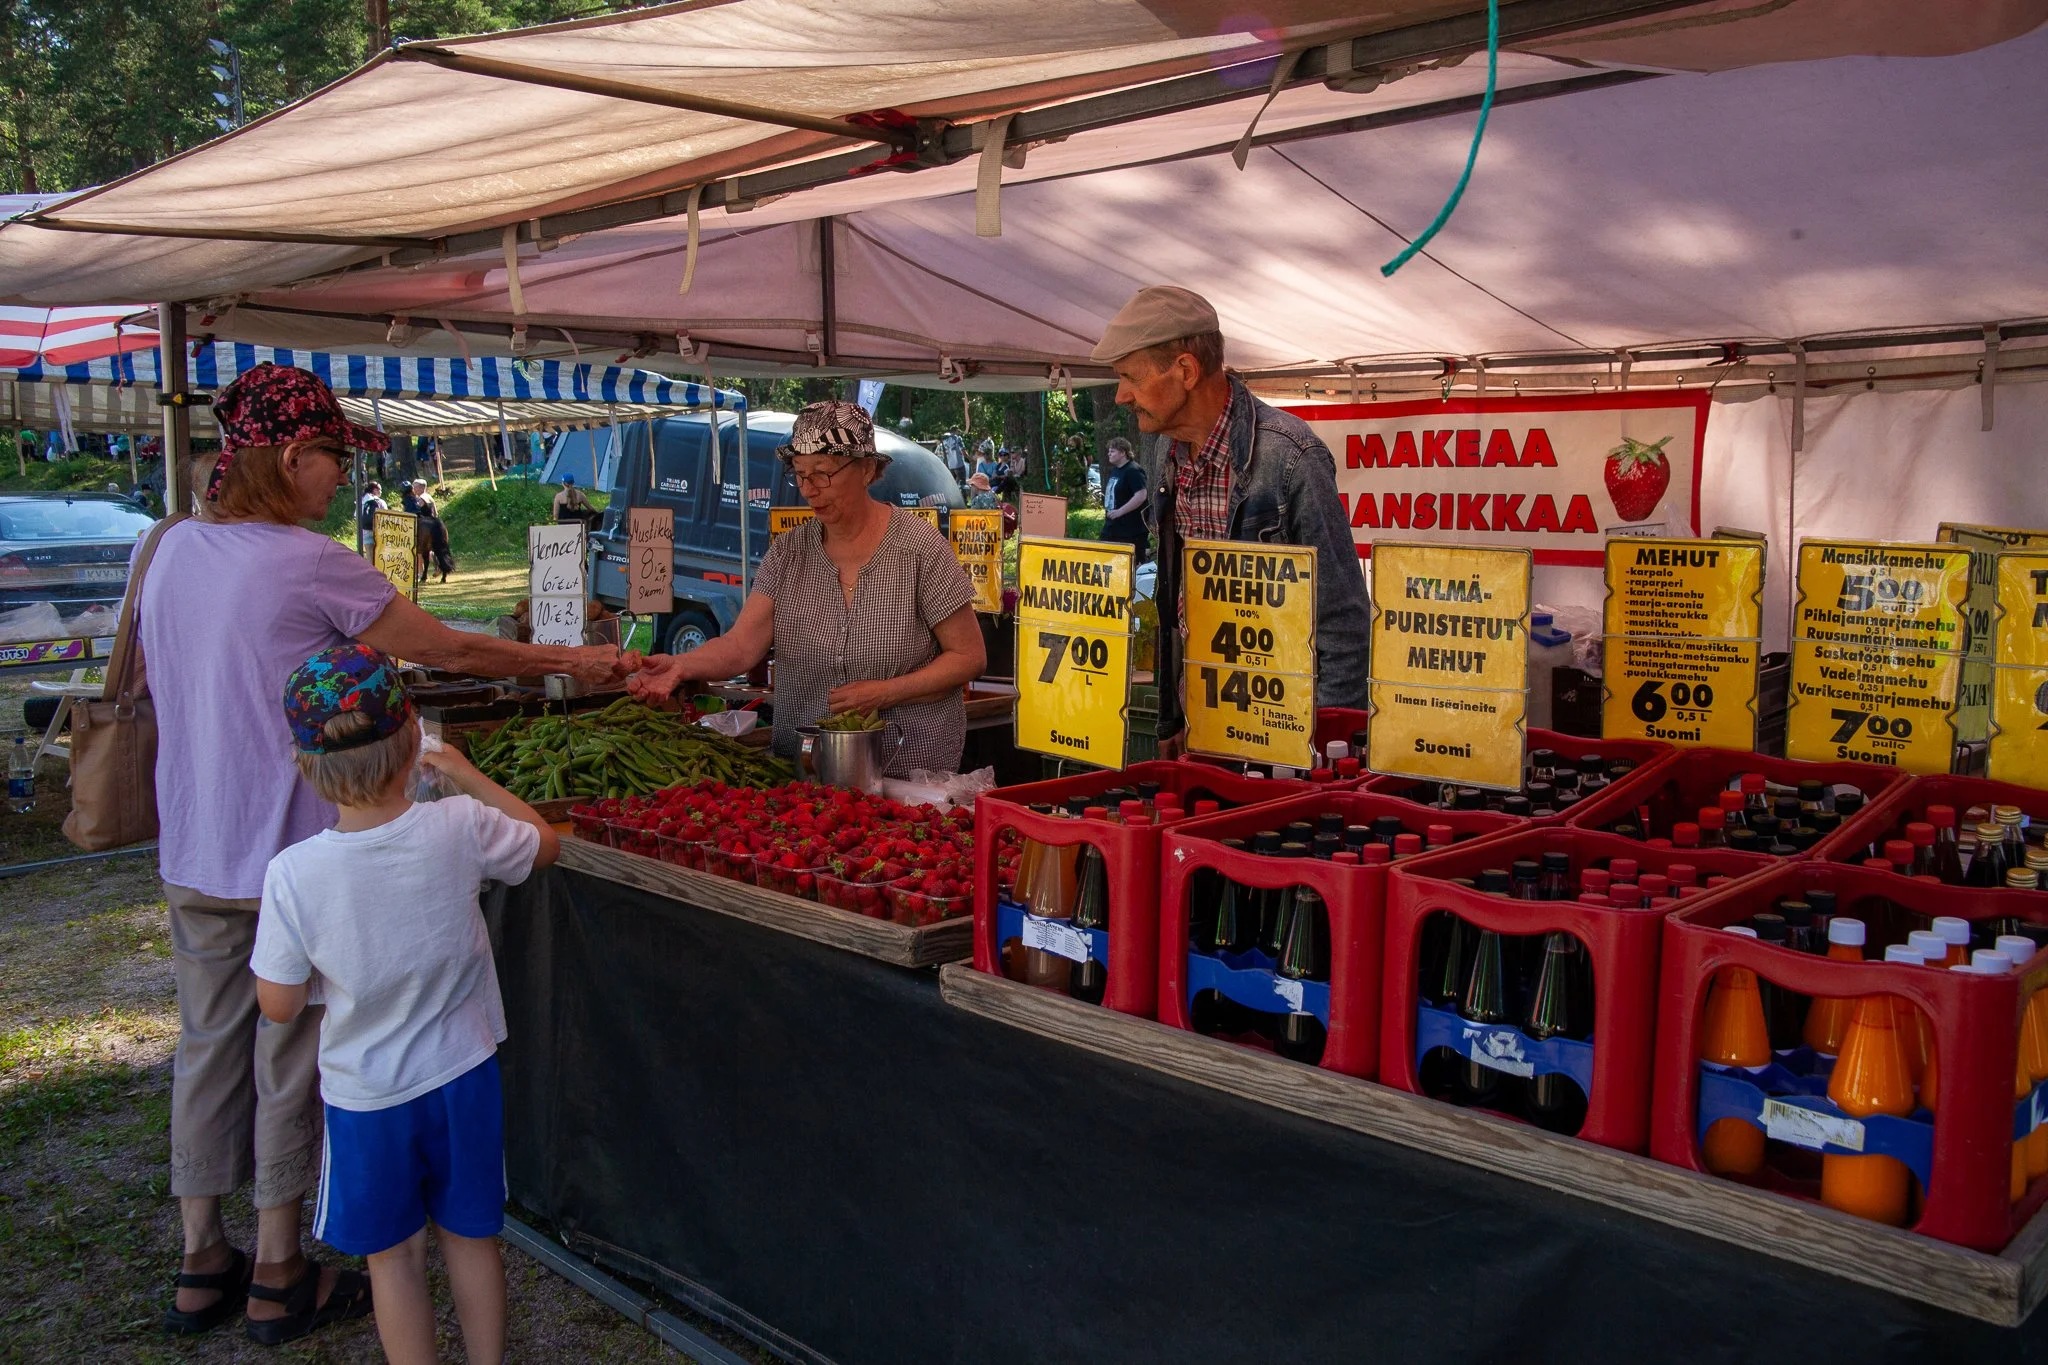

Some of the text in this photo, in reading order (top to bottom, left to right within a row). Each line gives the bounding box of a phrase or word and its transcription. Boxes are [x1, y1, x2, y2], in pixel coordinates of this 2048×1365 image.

[1346, 428, 1558, 469] MAKEAA
[965, 519, 987, 531] AITO
[607, 554, 630, 563] STRO
[958, 543, 995, 556] SINAPPI
[1636, 548, 1720, 568] MEHUT
[1821, 547, 1946, 569] Mansikkamehu
[1042, 559, 1112, 588] MAKEAT
[1192, 550, 1310, 583] OMENA-
[1625, 567, 1674, 578] -karpalo
[1203, 577, 1286, 608] MEHU
[1406, 574, 1492, 603] KYLMÄ-
[1625, 579, 1684, 589] -raparperi
[1625, 588, 1705, 600] -karviaismehu
[1023, 585, 1126, 620] MANSIKKAT
[1625, 598, 1703, 610] -marja-aronia
[1882, 604, 1916, 613] pullo
[1234, 608, 1260, 619] 100%
[1624, 609, 1708, 620] -mustaherukka
[1804, 608, 1956, 632] Pihlajanmarjamehu
[1384, 609, 1517, 641] PURISTETUT
[1624, 619, 1679, 629] -mustikka
[1806, 627, 1949, 650] Ruusunmarjamehu
[1245, 655, 1261, 666] 0,5
[1407, 646, 1486, 674] MEHUT
[1814, 645, 1936, 669] Saskatoonmehu
[1819, 666, 1928, 689] Vadelmamehu
[1859, 683, 1879, 692] 0,35
[1394, 694, 1496, 714] Ilman lisäaineita
[1797, 682, 1951, 711] Variksenmarjamehu
[1860, 702, 1874, 711] 0,5
[1253, 706, 1260, 716] 3
[1268, 709, 1298, 722] hana-
[1676, 711, 1696, 722] 0,5
[1226, 725, 1270, 746] Suomi
[1262, 718, 1305, 733] laatikko
[1645, 724, 1700, 741] Suomi
[1050, 729, 1090, 751] Suomi
[1414, 738, 1471, 758] Suomi
[1872, 740, 1906, 750] pullo
[1837, 745, 1897, 766] Suomi
